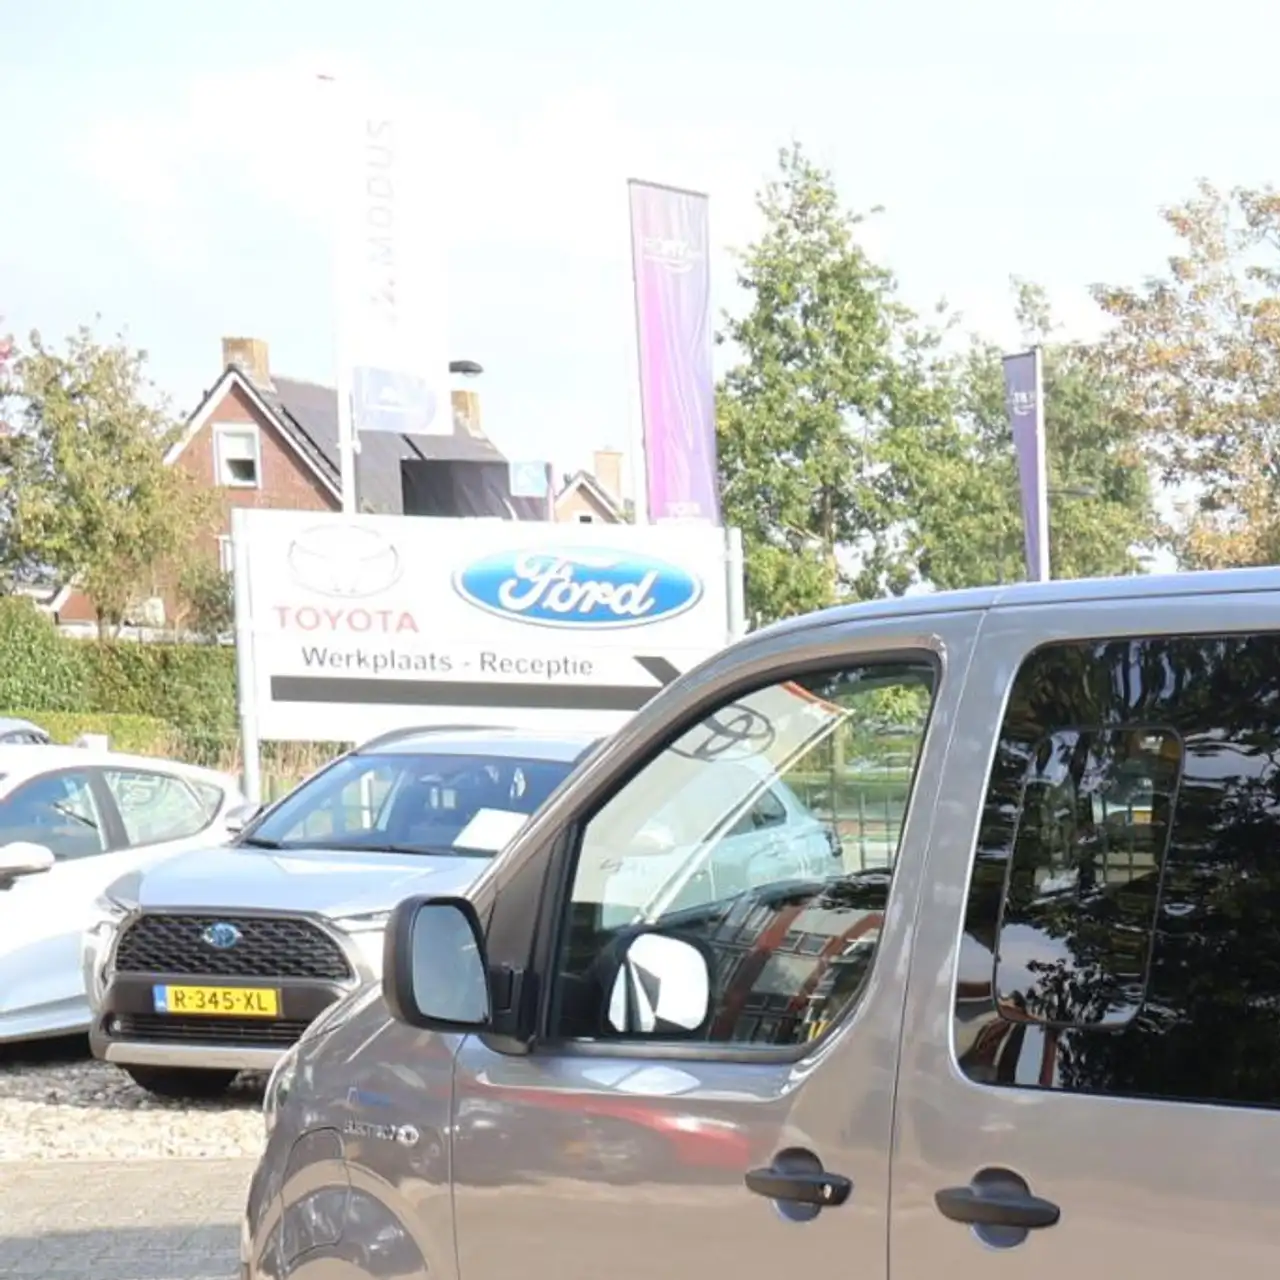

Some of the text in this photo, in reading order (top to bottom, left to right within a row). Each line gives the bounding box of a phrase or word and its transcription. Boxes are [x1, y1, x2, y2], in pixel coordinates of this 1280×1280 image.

[497, 550, 660, 615] Ford
[273, 605, 420, 634] TOYOTA
[301, 647, 453, 674] Werkplaats
[480, 651, 594, 678] Receptie
[173, 989, 268, 1012] R-345-XL
